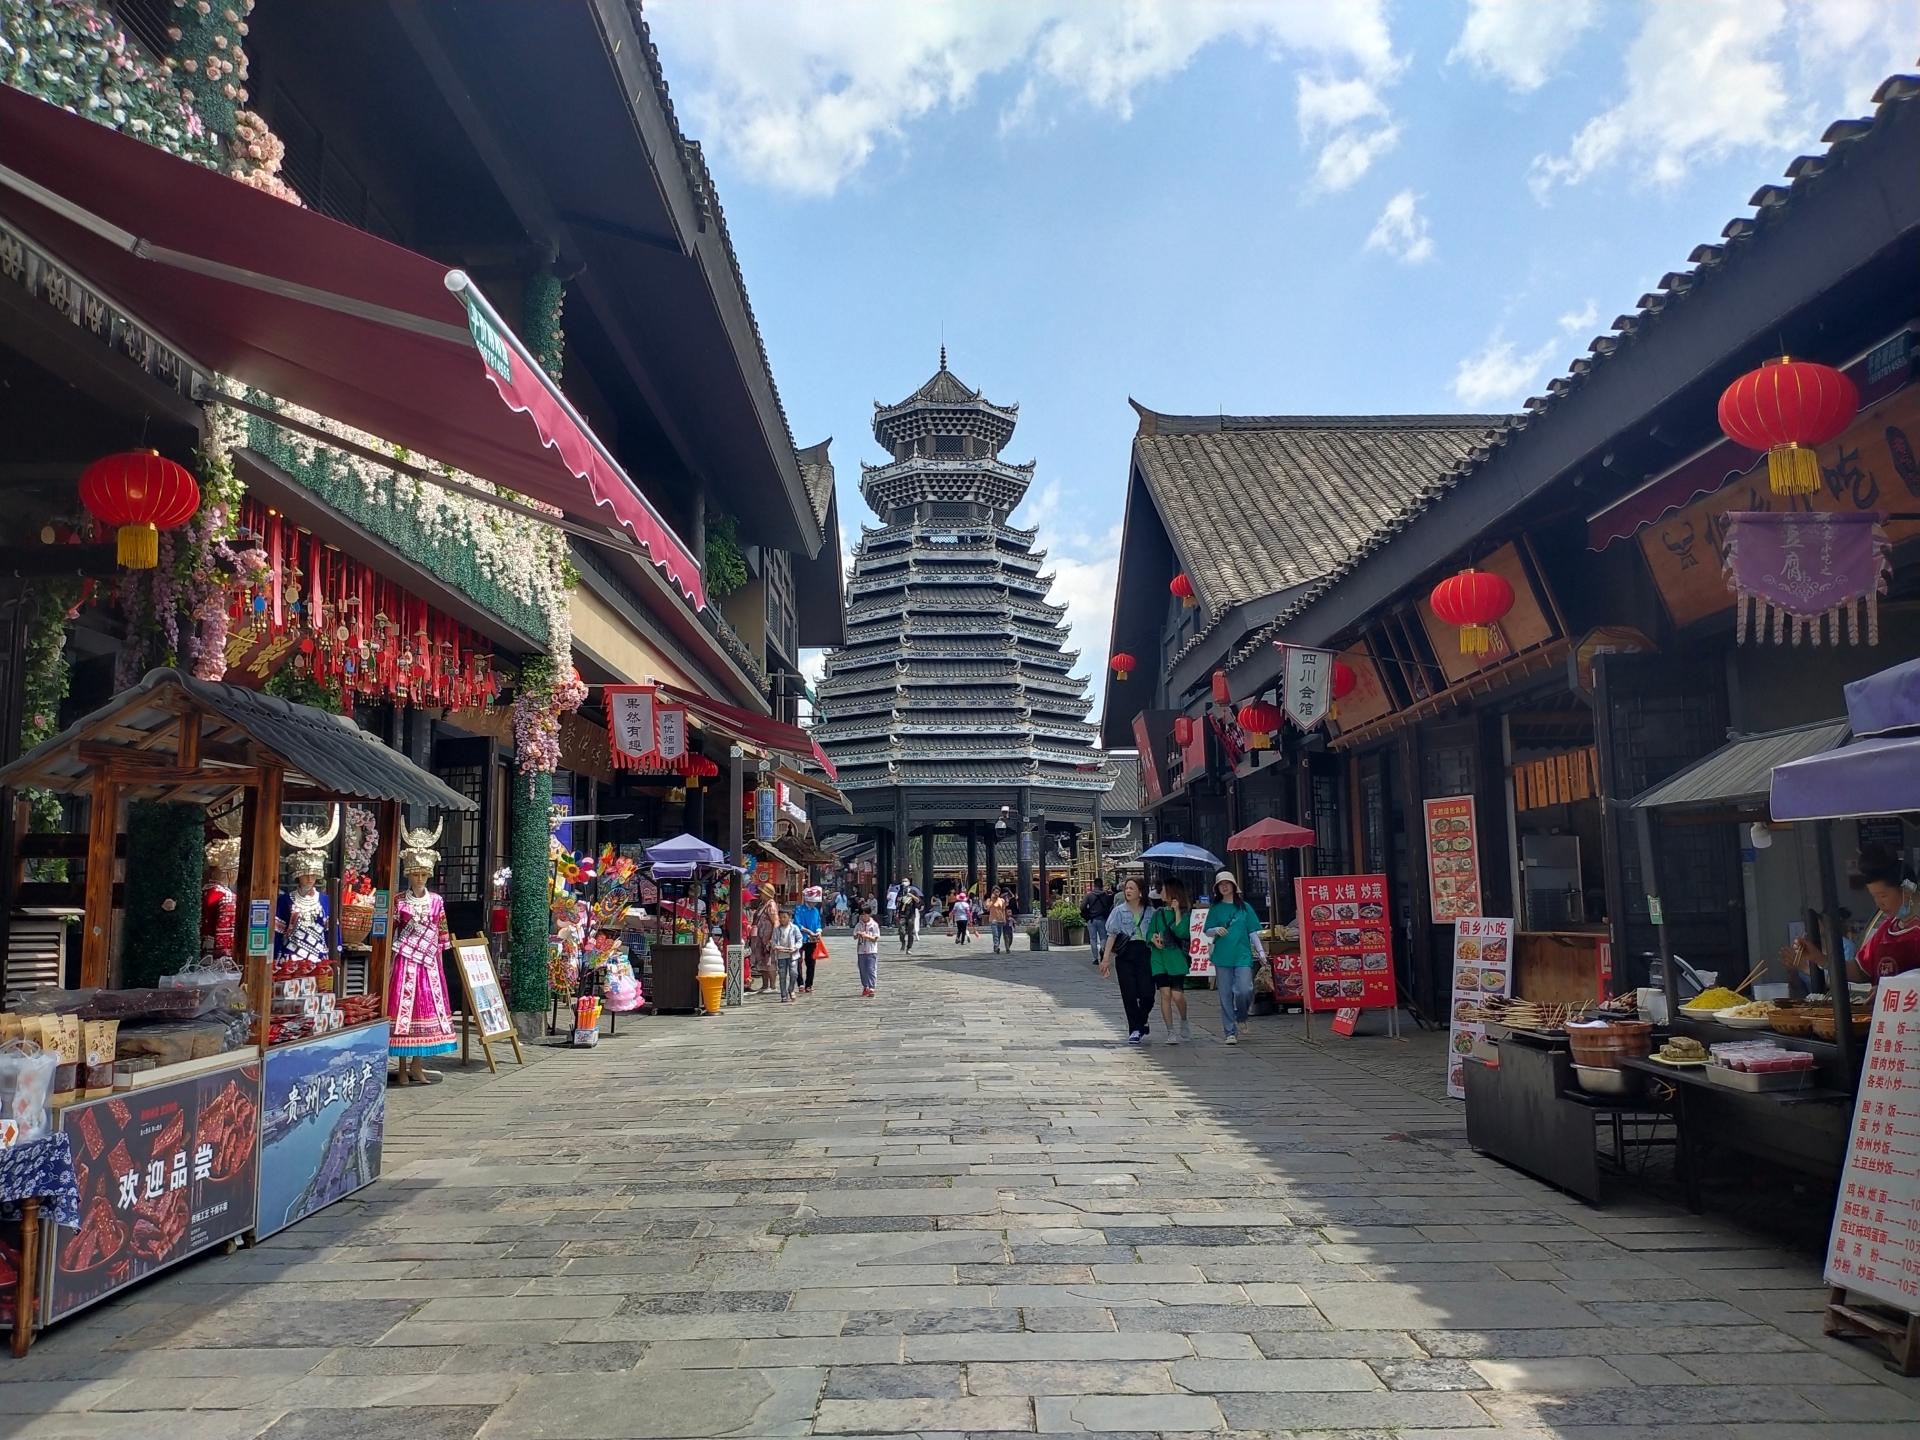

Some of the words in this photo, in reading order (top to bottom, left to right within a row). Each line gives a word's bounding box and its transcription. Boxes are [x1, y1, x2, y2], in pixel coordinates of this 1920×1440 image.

[1299, 654, 1316, 716] 四川会馆
[626, 698, 643, 752] 果然有趣
[1307, 885, 1329, 901] 干锅
[1335, 884, 1356, 900] 火锅
[1360, 882, 1383, 899] 炒菜
[1459, 920, 1507, 936] 侗乡小吃
[1882, 988, 1919, 1013] 侗乡
[1869, 1056, 1905, 1072] 腊肉炒饭
[1867, 1073, 1902, 1091] 各类小炒
[283, 1062, 373, 1125] 贵州土特产
[1855, 1136, 1891, 1155] 扬州炒饭
[1852, 1154, 1893, 1175] 土豆丝炒饭
[118, 1143, 213, 1209] 欢迎品尝
